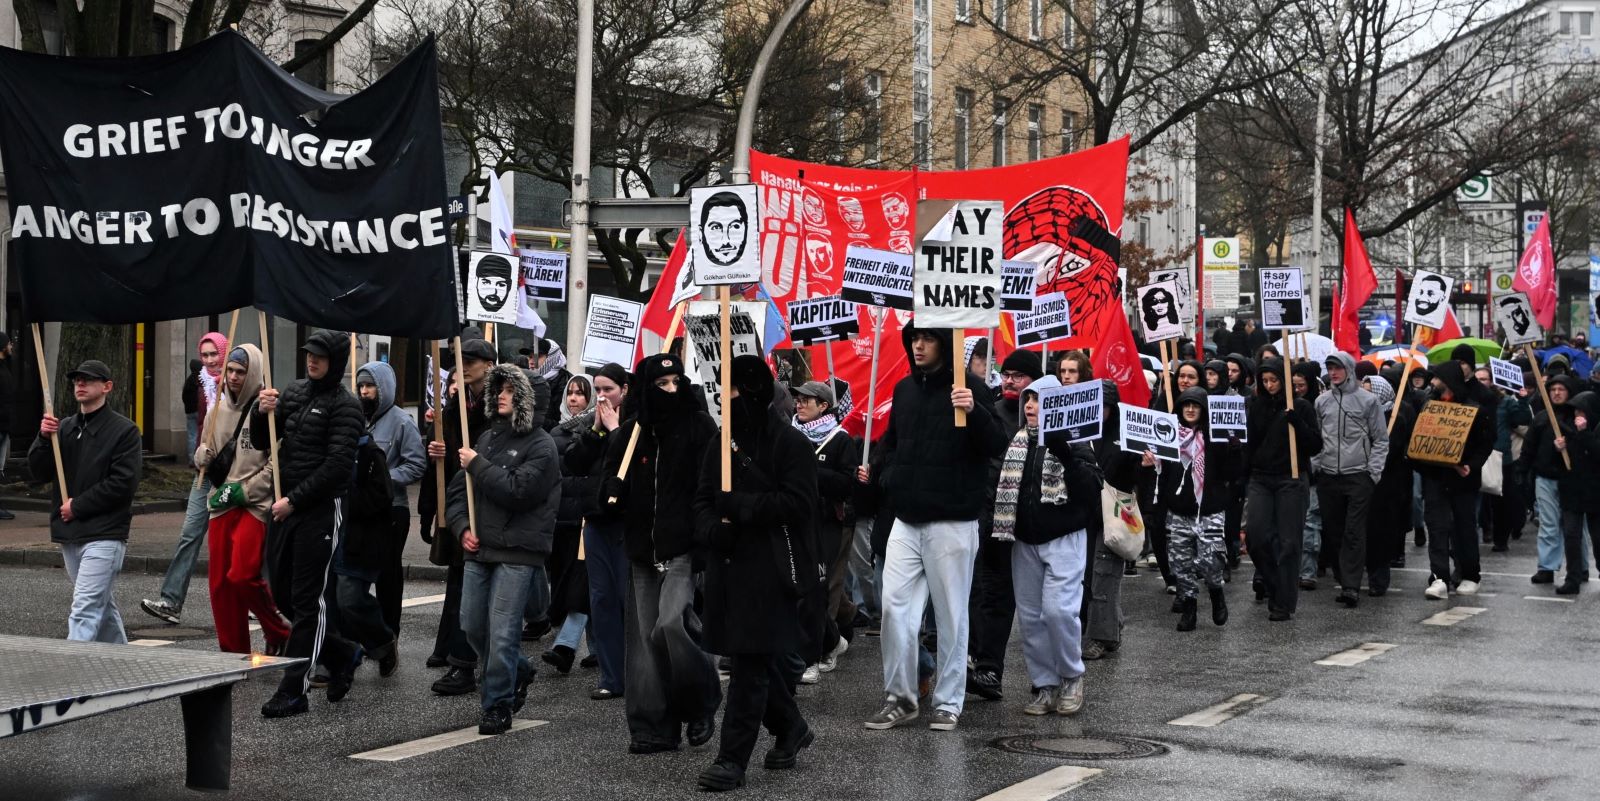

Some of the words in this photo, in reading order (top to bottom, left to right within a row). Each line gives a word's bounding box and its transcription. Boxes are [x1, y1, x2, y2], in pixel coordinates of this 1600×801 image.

[63, 115, 187, 158] GRIEF
[195, 103, 248, 143] TO
[448, 200, 463, 213] aße
[12, 205, 154, 245] ANGER
[160, 197, 220, 239] TO
[230, 192, 446, 253] RESISTANCE
[952, 208, 992, 235] AY
[845, 256, 881, 272] FREIHEIT
[882, 261, 899, 275] FÜR
[921, 245, 994, 275] THEIR
[1263, 271, 1291, 282] #say
[1263, 281, 1289, 290] their
[923, 284, 995, 310] NAMES
[1263, 289, 1300, 298] names
[593, 308, 627, 319] Erinnerung
[791, 301, 854, 326] KAPITAL!
[590, 322, 624, 334] Aufklärung
[591, 315, 634, 328] Gerechtigkeit
[1017, 319, 1033, 332] ODER
[588, 330, 634, 343] Konsequenzen
[1042, 387, 1100, 410] GERECHTIGKEIT
[1424, 403, 1447, 415] HERR
[1043, 410, 1064, 430] FÜR
[1066, 404, 1100, 427] HANAU!
[1126, 410, 1153, 426] HANAU
[1126, 423, 1153, 435] GEDENKEN
